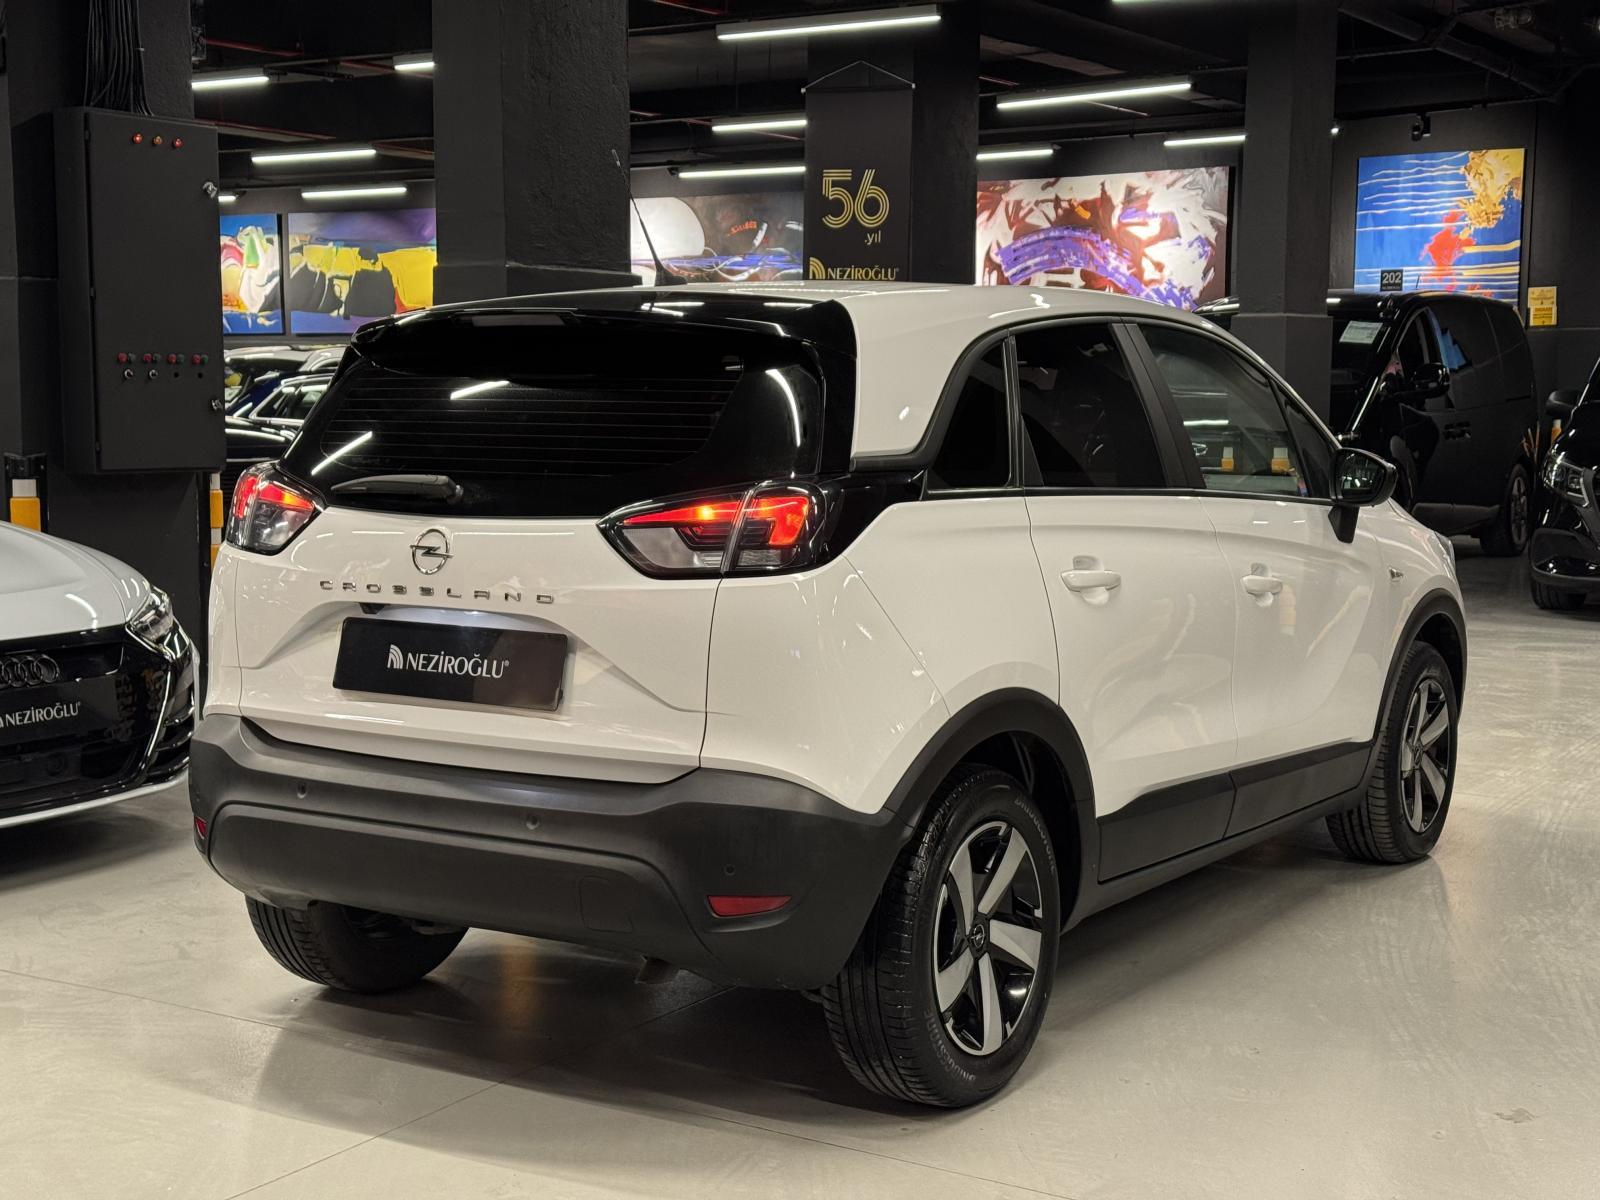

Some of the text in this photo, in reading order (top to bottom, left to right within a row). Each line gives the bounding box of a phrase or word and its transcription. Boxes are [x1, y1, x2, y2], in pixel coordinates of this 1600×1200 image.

[822, 169, 890, 228] 56
[827, 265, 897, 280] NEZİROĞLU
[1382, 272, 1402, 284] 202
[319, 580, 554, 604] CROSSLAND
[406, 651, 505, 679] NEZİROĞLU
